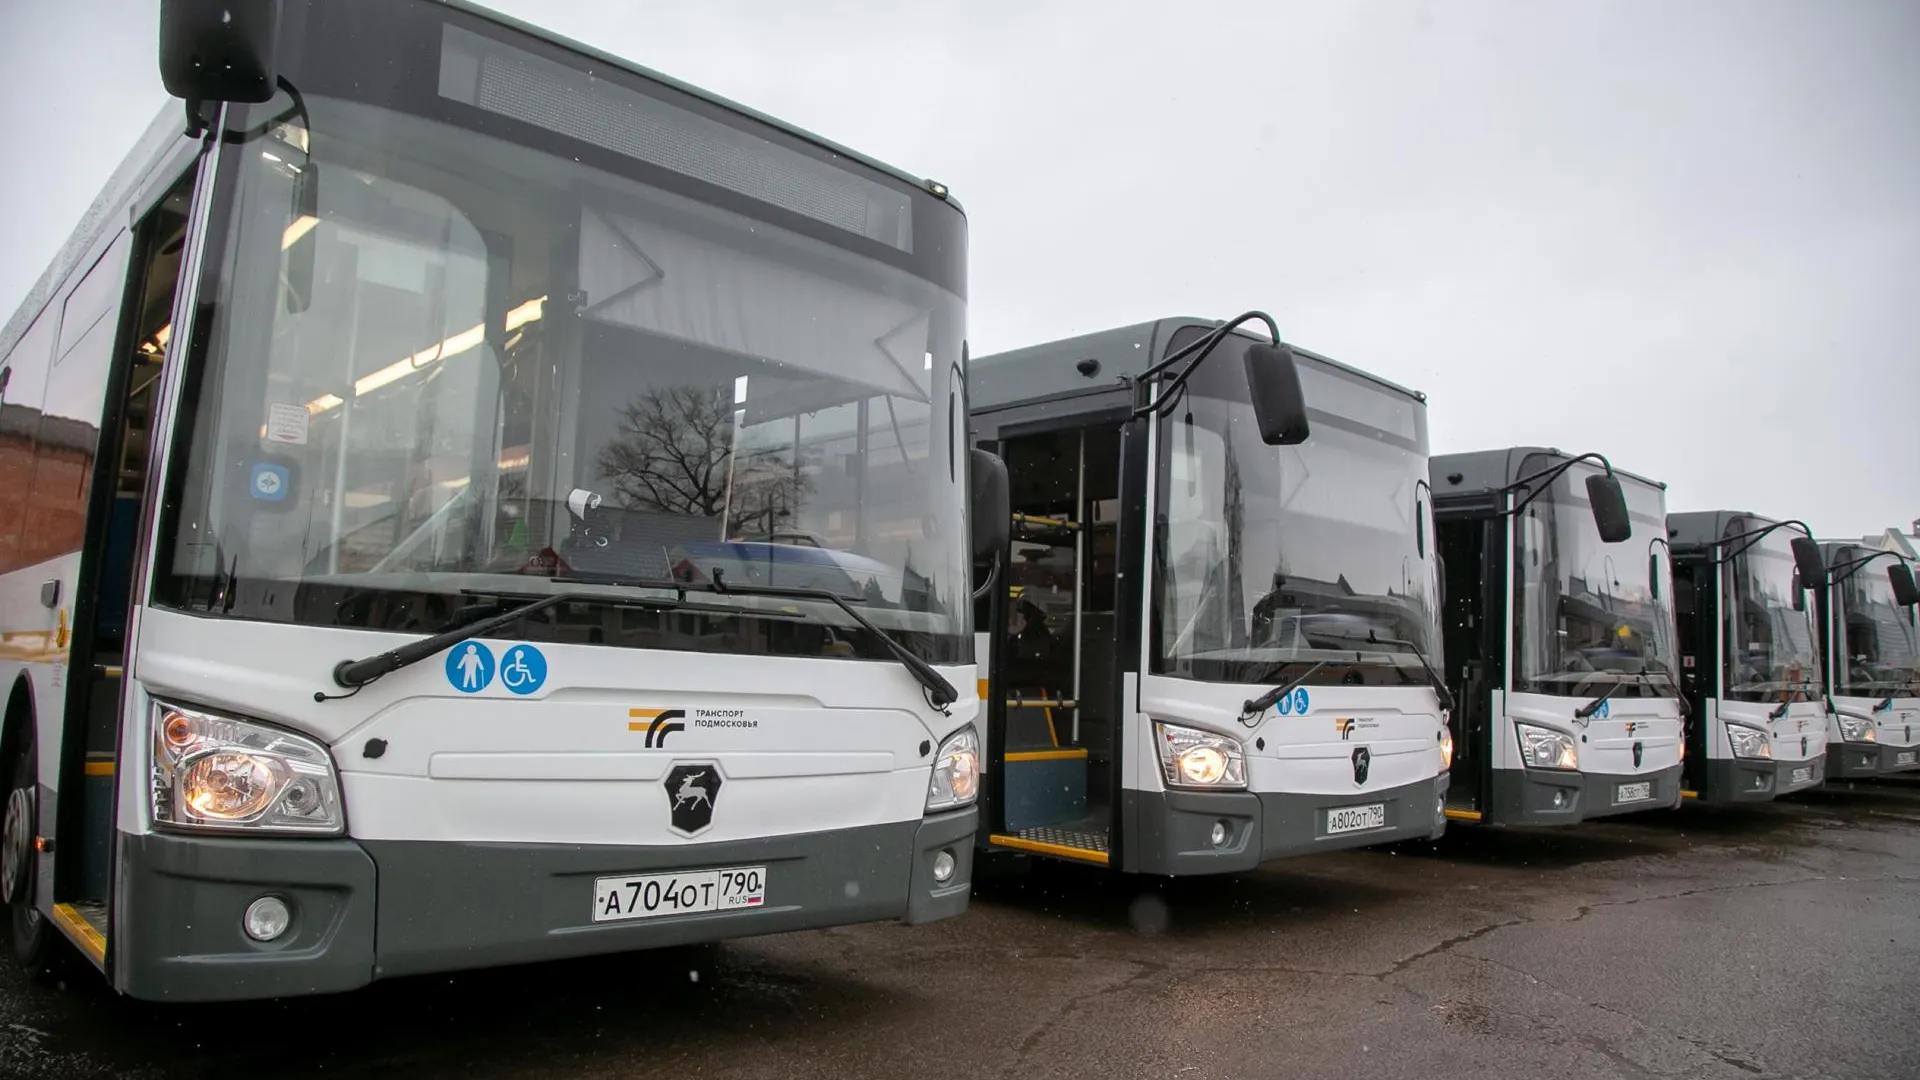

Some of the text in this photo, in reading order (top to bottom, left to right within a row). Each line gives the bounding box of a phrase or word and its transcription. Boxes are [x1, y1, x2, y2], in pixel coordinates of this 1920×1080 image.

[695, 720, 758, 728] ПОДМОСКОВЬЯ
[1332, 811, 1367, 829] А802ОТ
[605, 871, 759, 915] А704ОТ 790
[728, 895, 747, 905] RUS
